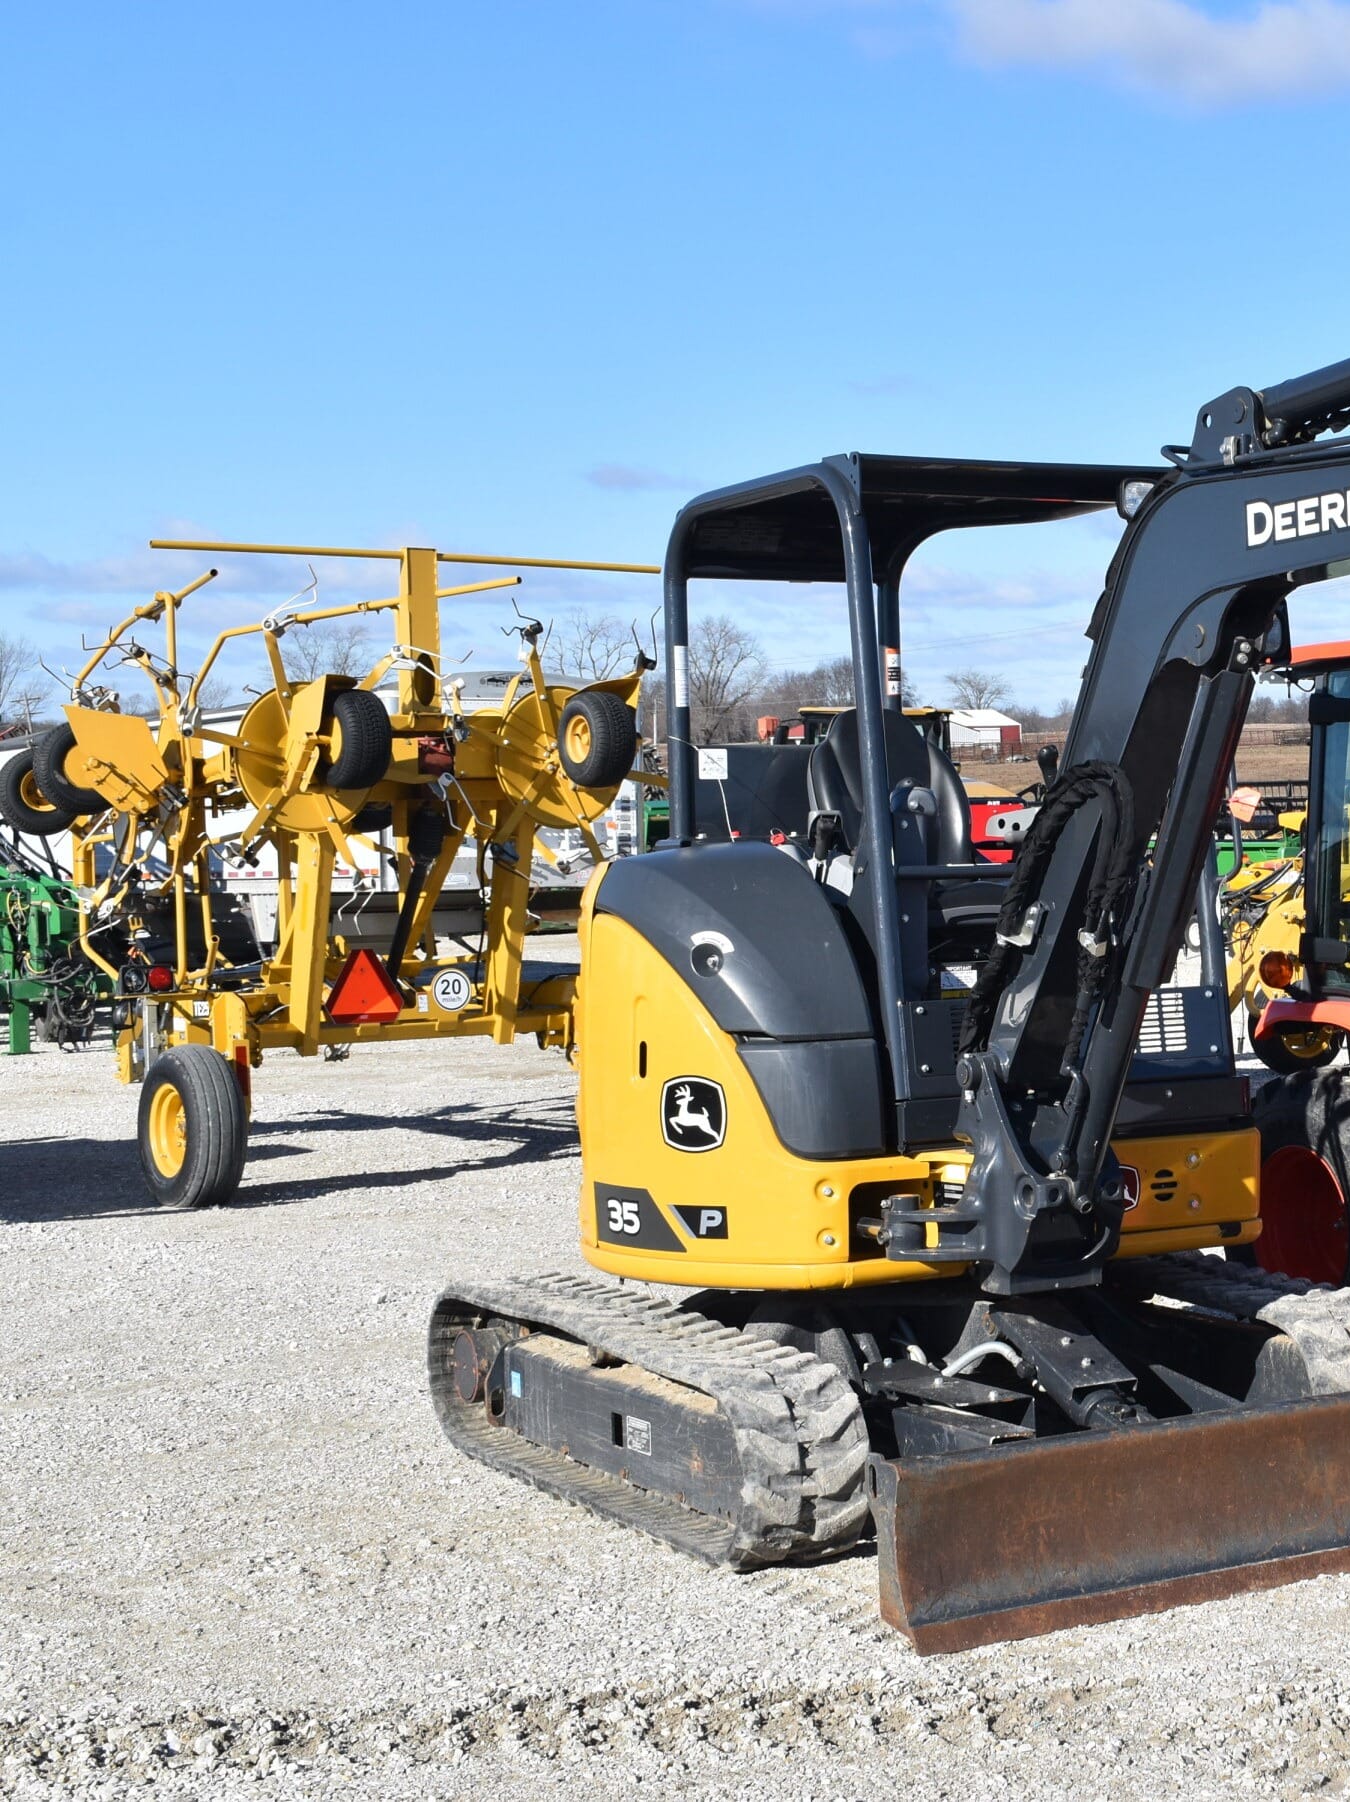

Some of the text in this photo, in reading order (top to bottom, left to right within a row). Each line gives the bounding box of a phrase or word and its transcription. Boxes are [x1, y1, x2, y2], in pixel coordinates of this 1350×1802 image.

[441, 979, 461, 995] 20
[607, 1199, 722, 1235] 35 P
